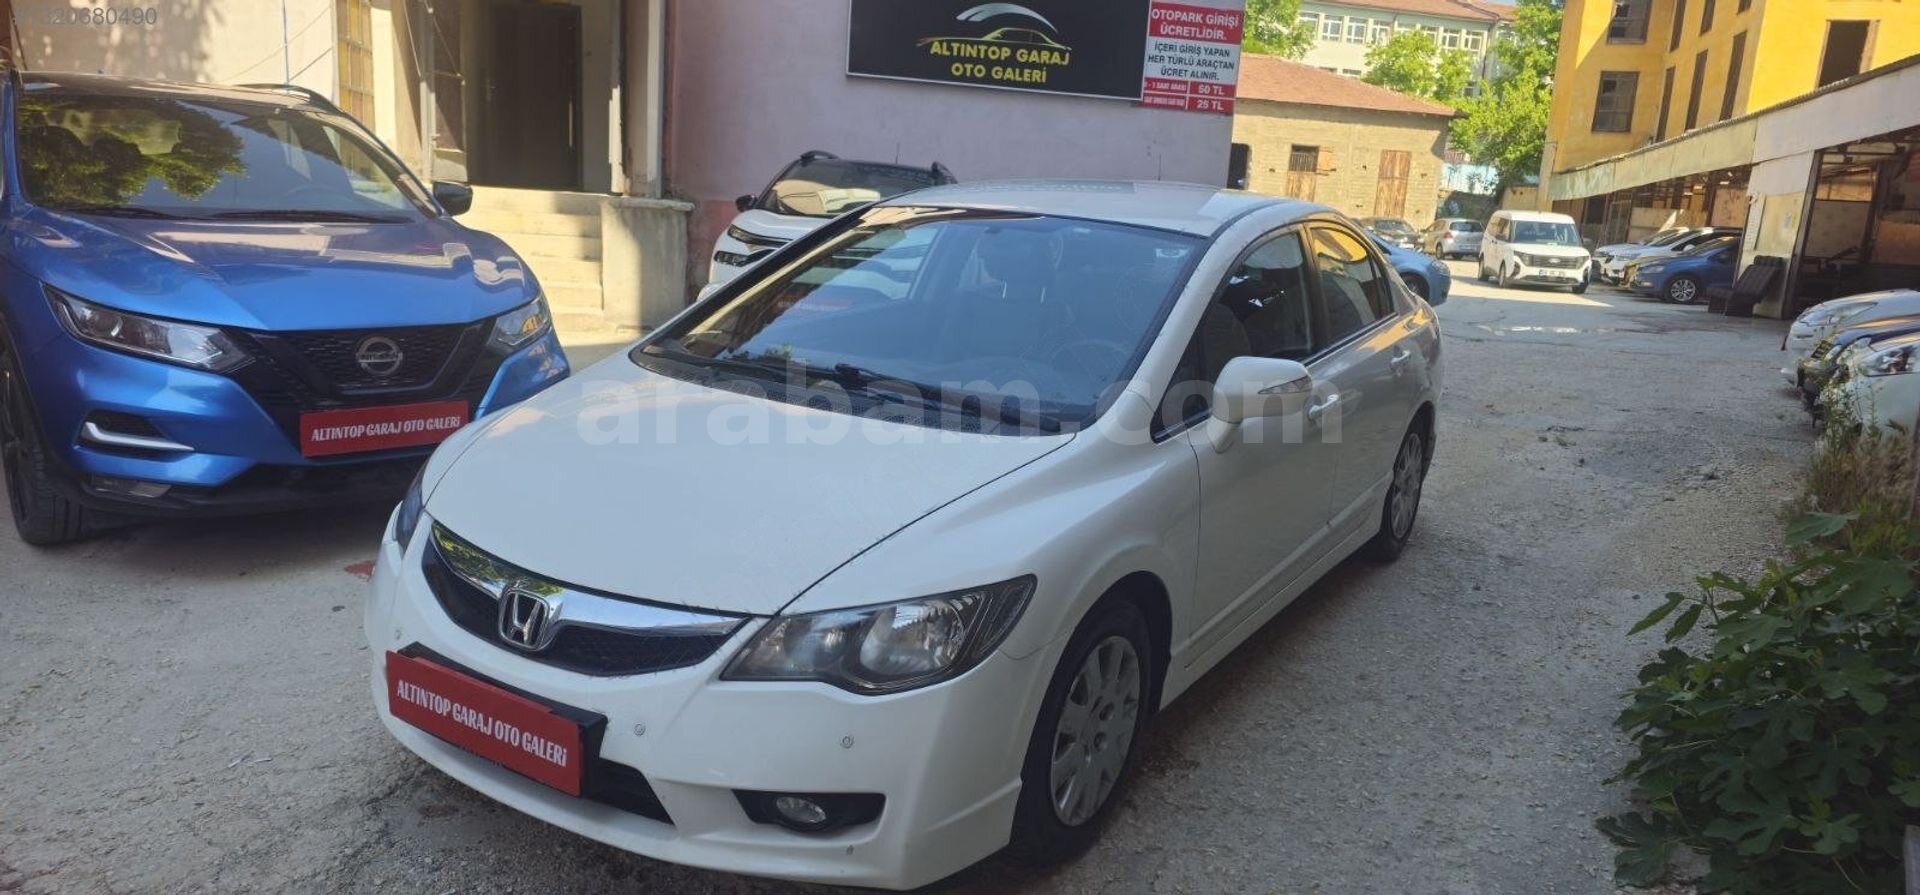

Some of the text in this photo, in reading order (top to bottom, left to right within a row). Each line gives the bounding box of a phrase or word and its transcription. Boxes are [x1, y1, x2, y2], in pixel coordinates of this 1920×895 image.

[1152, 9, 1203, 23] OTOPARK
[930, 42, 1070, 65] ALTINTOP GARAJ
[1204, 47, 1230, 57] YAPAN
[1148, 55, 1165, 63] HER
[1196, 59, 1235, 70] ARAÇTAN
[951, 63, 1047, 82] OTO GALERİ
[1161, 65, 1188, 77] ÜCRET
[1212, 86, 1225, 95] TL
[1212, 101, 1225, 110] TL
[312, 425, 364, 441] ALTINTOP
[366, 421, 401, 437] GARAJ
[403, 420, 425, 433] OTO
[397, 680, 451, 716] ALTINTOP
[452, 703, 492, 735] GARAJ
[494, 721, 520, 745] OTO
